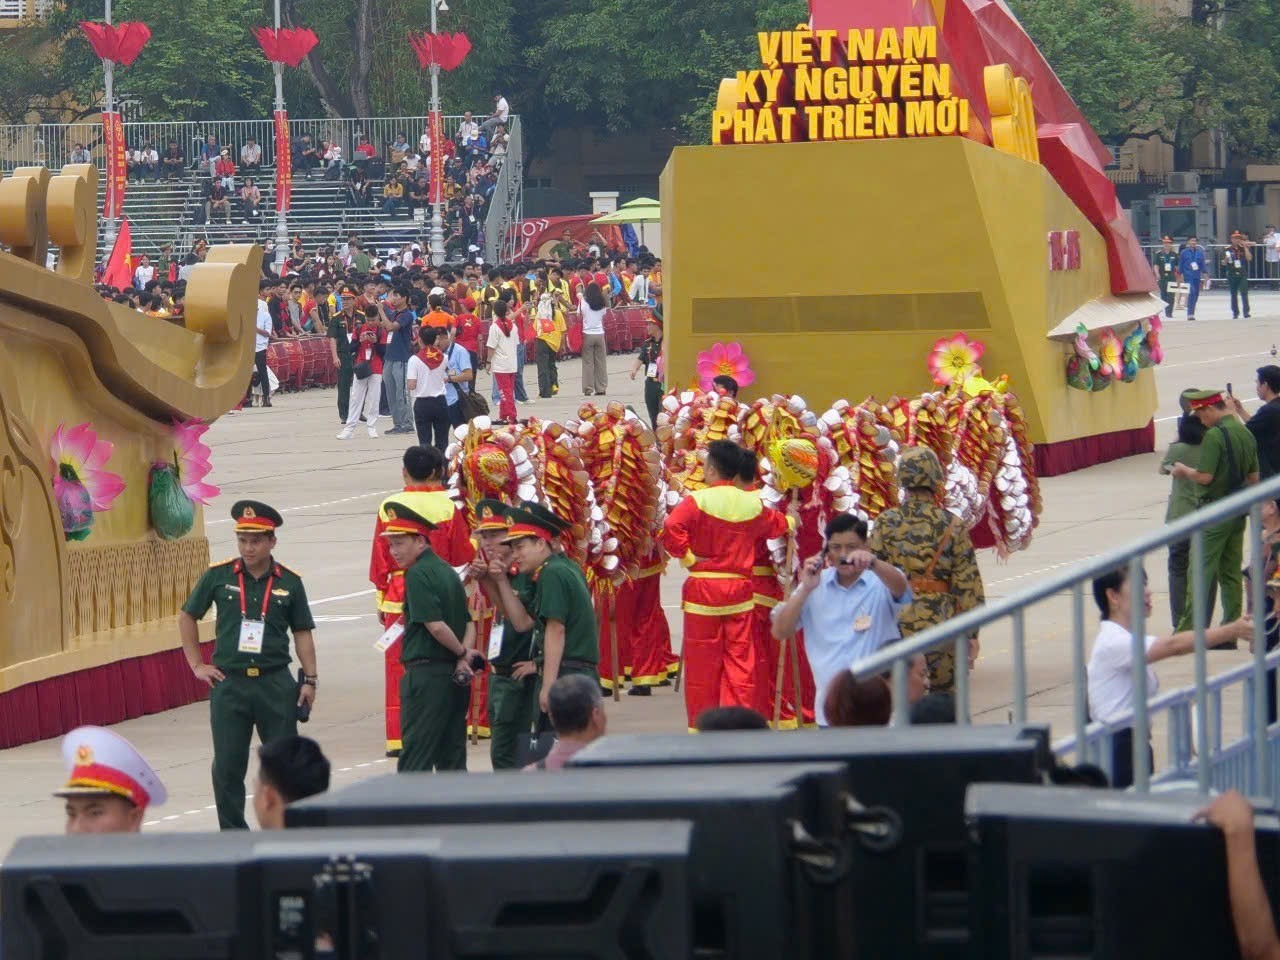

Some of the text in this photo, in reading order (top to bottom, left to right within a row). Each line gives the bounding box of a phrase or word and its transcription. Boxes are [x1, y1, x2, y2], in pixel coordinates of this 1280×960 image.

[847, 26, 938, 61] NAM
[736, 57, 951, 103] KỶ NGUYÊN
[712, 90, 970, 145] PHÁT TRIỂN MỚI
